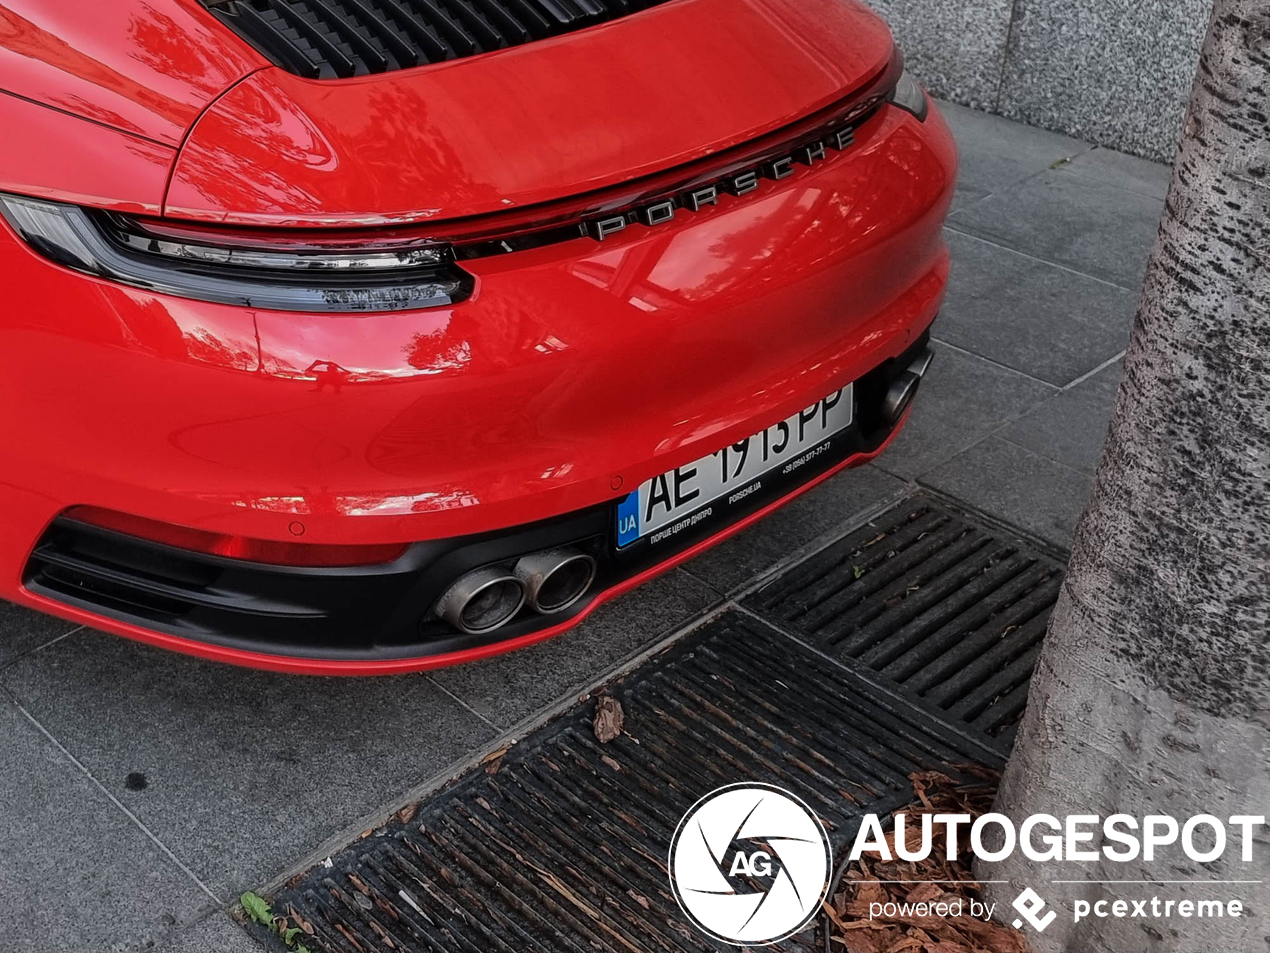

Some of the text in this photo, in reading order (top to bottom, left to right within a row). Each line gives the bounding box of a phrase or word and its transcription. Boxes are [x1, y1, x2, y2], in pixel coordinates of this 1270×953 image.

[596, 127, 856, 241] PORSCHE
[646, 466, 700, 522] AE
[799, 388, 842, 442] PP
[619, 514, 636, 535] UA
[650, 527, 672, 545] ПОРШЕ
[672, 518, 691, 534] ЦЕНТР
